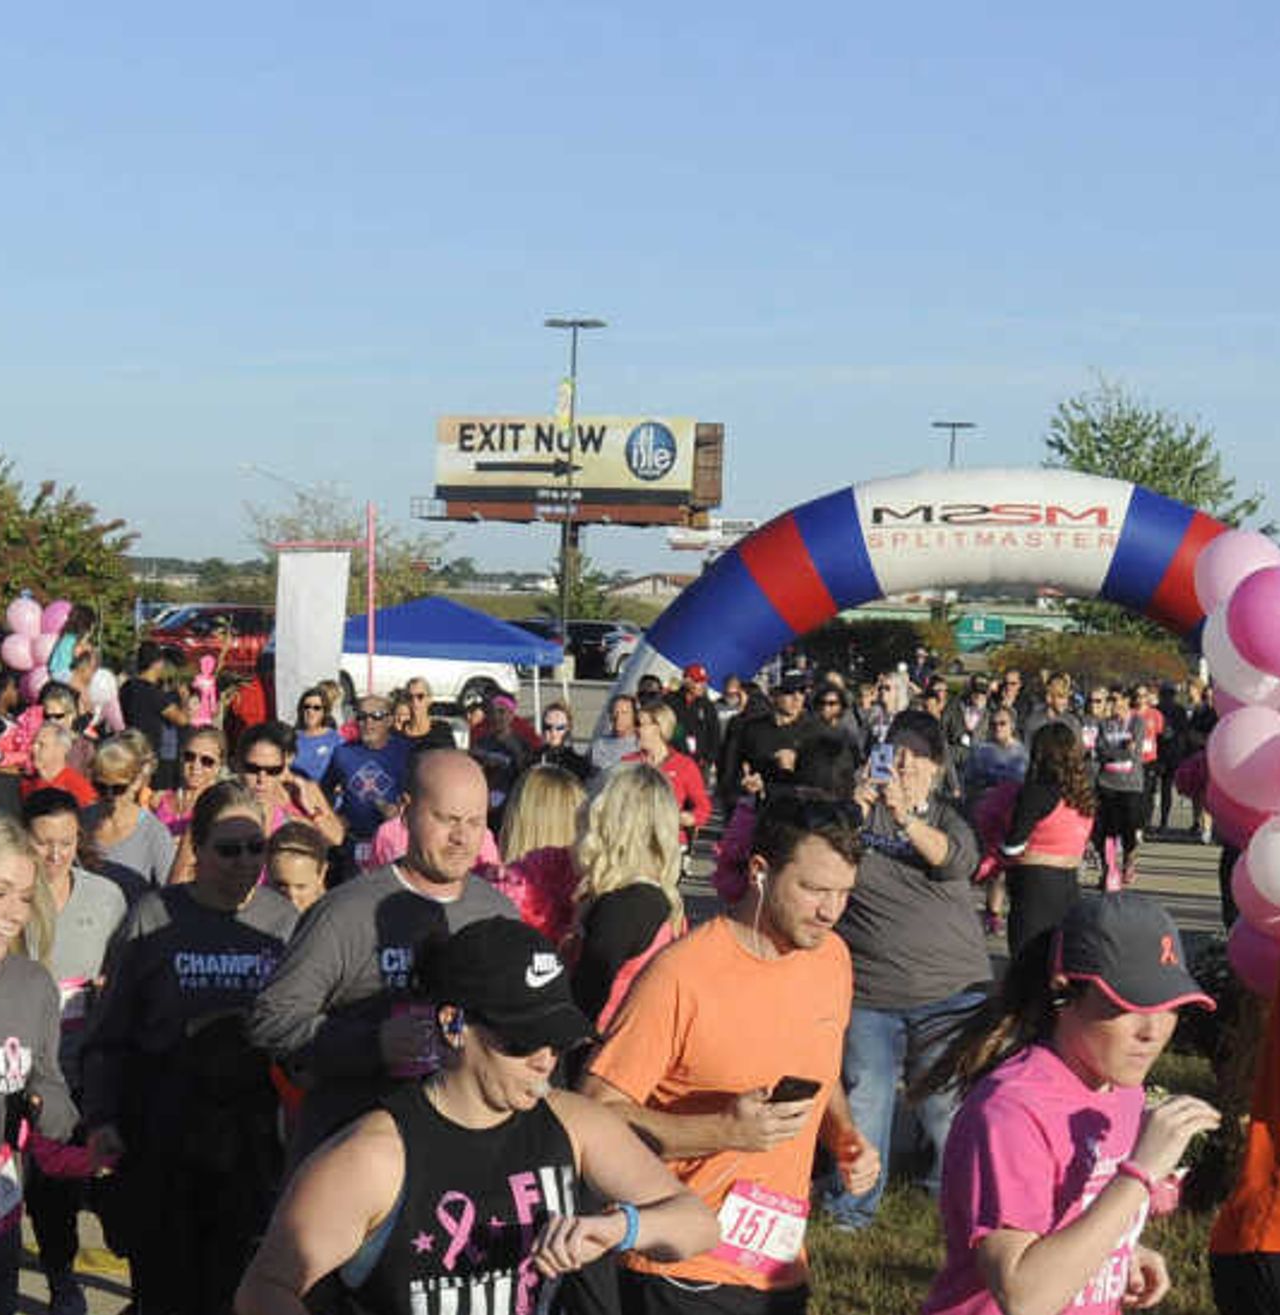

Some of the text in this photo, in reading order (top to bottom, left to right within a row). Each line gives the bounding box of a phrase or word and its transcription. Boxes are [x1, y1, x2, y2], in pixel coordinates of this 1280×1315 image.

[458, 422, 607, 454] EXIT NOW
[872, 504, 1110, 527] M2SM
[726, 1205, 778, 1250] 151
